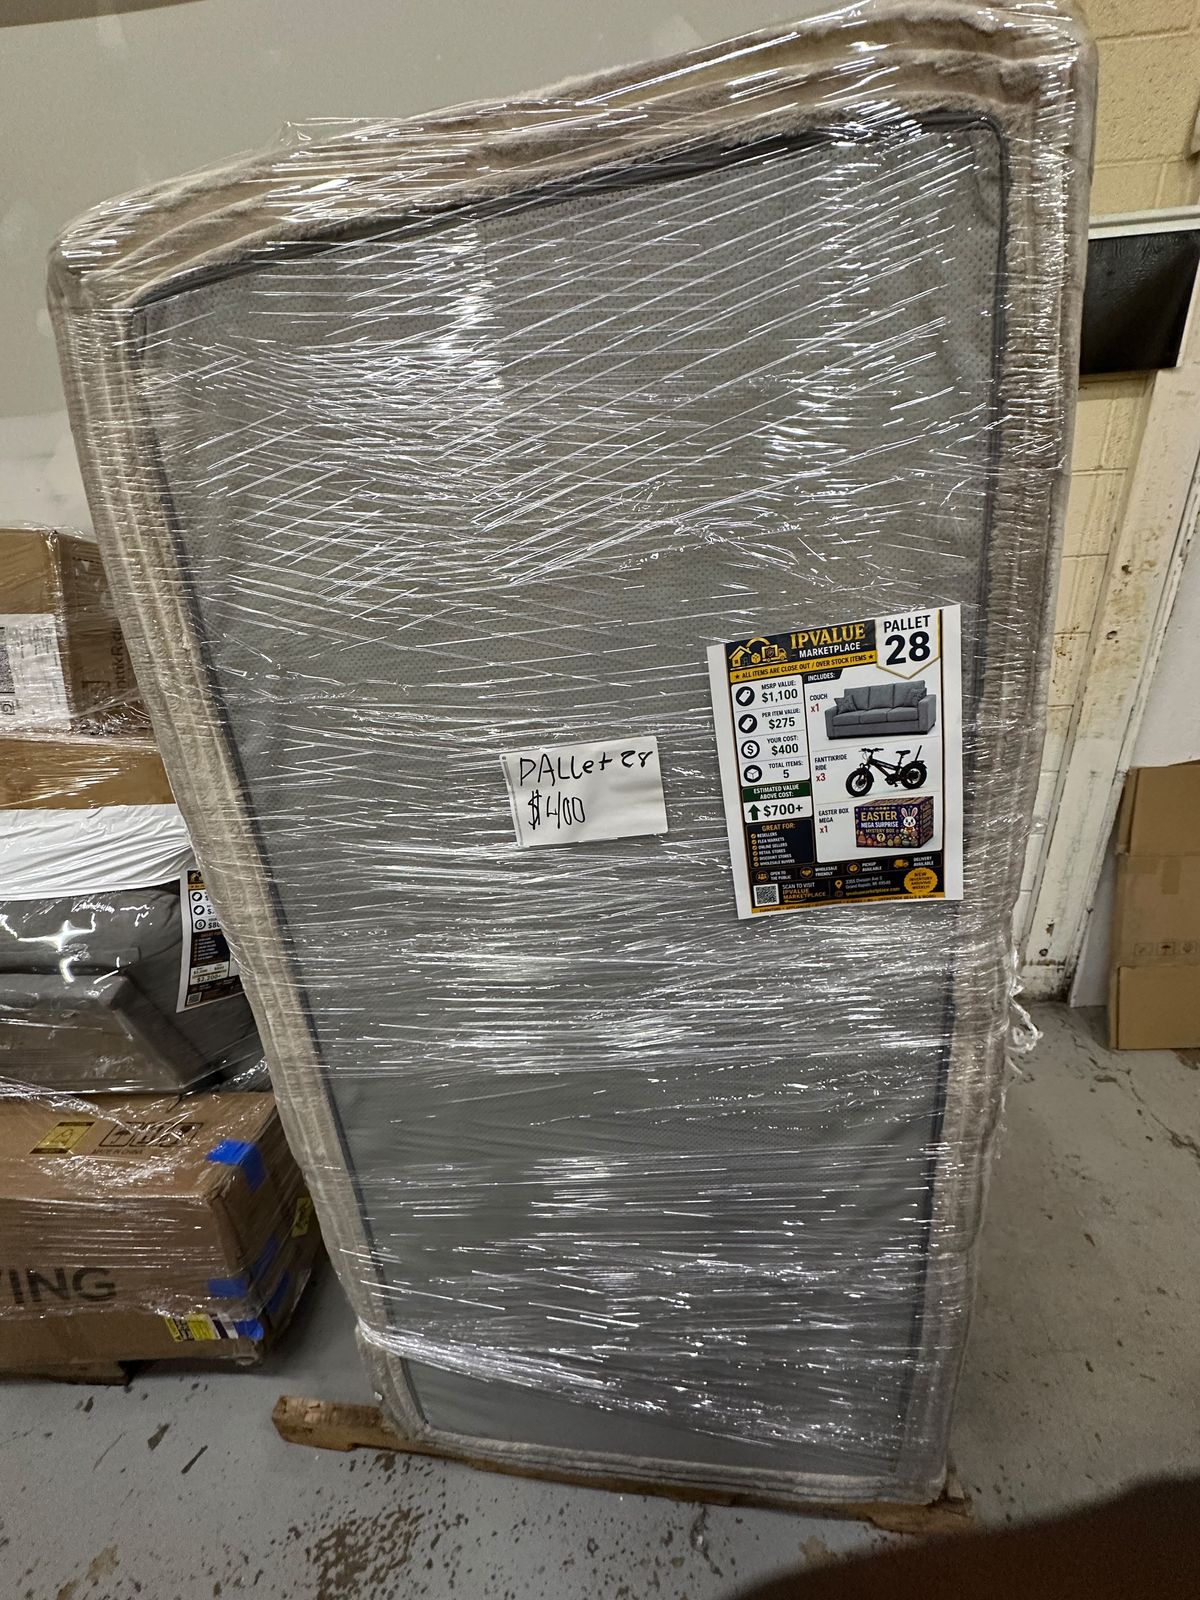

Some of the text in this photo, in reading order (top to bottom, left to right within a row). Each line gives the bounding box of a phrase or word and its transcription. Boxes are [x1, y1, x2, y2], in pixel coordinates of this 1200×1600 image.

[884, 615, 931, 633] PALLET
[790, 623, 866, 650] IPVALUE
[799, 642, 861, 658] MARKETPLACE
[885, 631, 931, 666] 28
[781, 665, 798, 673] CLOSE
[816, 660, 830, 668] OVER
[850, 655, 867, 663] ITEMS
[808, 672, 835, 681] INCLUDES:
[762, 689, 798, 703] $1,100
[811, 704, 819, 712] x1
[769, 717, 795, 730] $275
[772, 744, 798, 756] $400
[815, 754, 847, 763] FANTTIKRIDE
[783, 769, 789, 779] 5
[816, 773, 826, 782] x3
[754, 786, 782, 794] ESTIMATED
[528, 790, 585, 830] $400
[764, 804, 803, 817] $700+
[861, 811, 897, 821] EASTER
[820, 825, 828, 833] x1
[783, 892, 826, 900] MARKETPLACE
